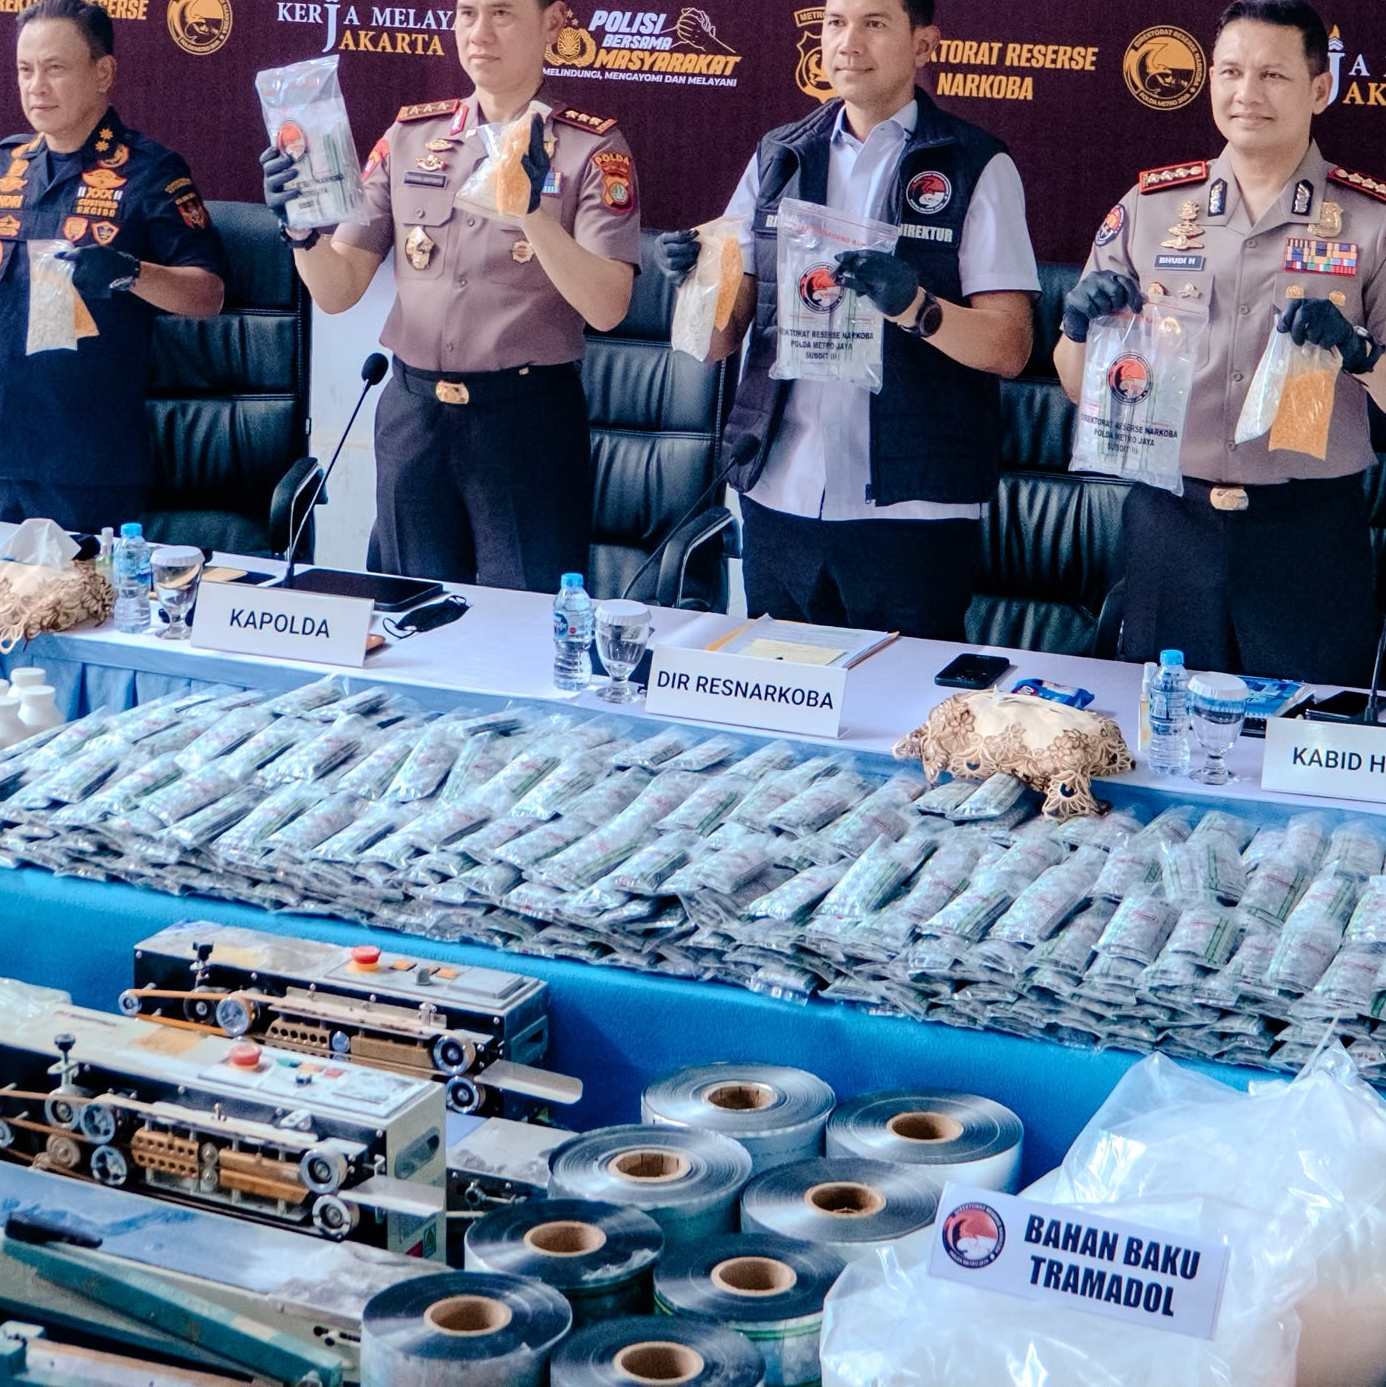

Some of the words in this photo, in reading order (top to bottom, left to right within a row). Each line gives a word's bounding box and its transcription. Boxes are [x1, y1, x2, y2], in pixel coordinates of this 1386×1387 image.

[588, 10, 666, 34] POLISI
[602, 34, 671, 50] BERSAMA
[593, 50, 742, 74] MASYARAKAT
[1005, 43, 1098, 70] RESERSE
[937, 72, 1033, 100] NARKOBA
[594, 153, 630, 166] POLDA
[898, 224, 953, 242] DIREKTUR
[1159, 257, 1187, 265] BHUDI
[791, 340, 811, 349] POLDA
[813, 341, 834, 350] METRO
[836, 342, 853, 350] JAYA
[812, 330, 841, 339] RESERSE
[842, 331, 873, 340] NARKOBA
[806, 351, 829, 360] SUBDIT
[1138, 437, 1155, 447] JAYA
[1145, 427, 1178, 438] NARKOBA
[230, 608, 329, 638] KAPOLDA
[657, 671, 690, 691] DIR
[696, 676, 833, 709] RESNARKOBA
[1293, 747, 1362, 771] KABID
[1024, 1214, 1119, 1262] BAHAN
[1123, 1237, 1201, 1280] BAKU
[1030, 1255, 1174, 1317] TRAMADOL
